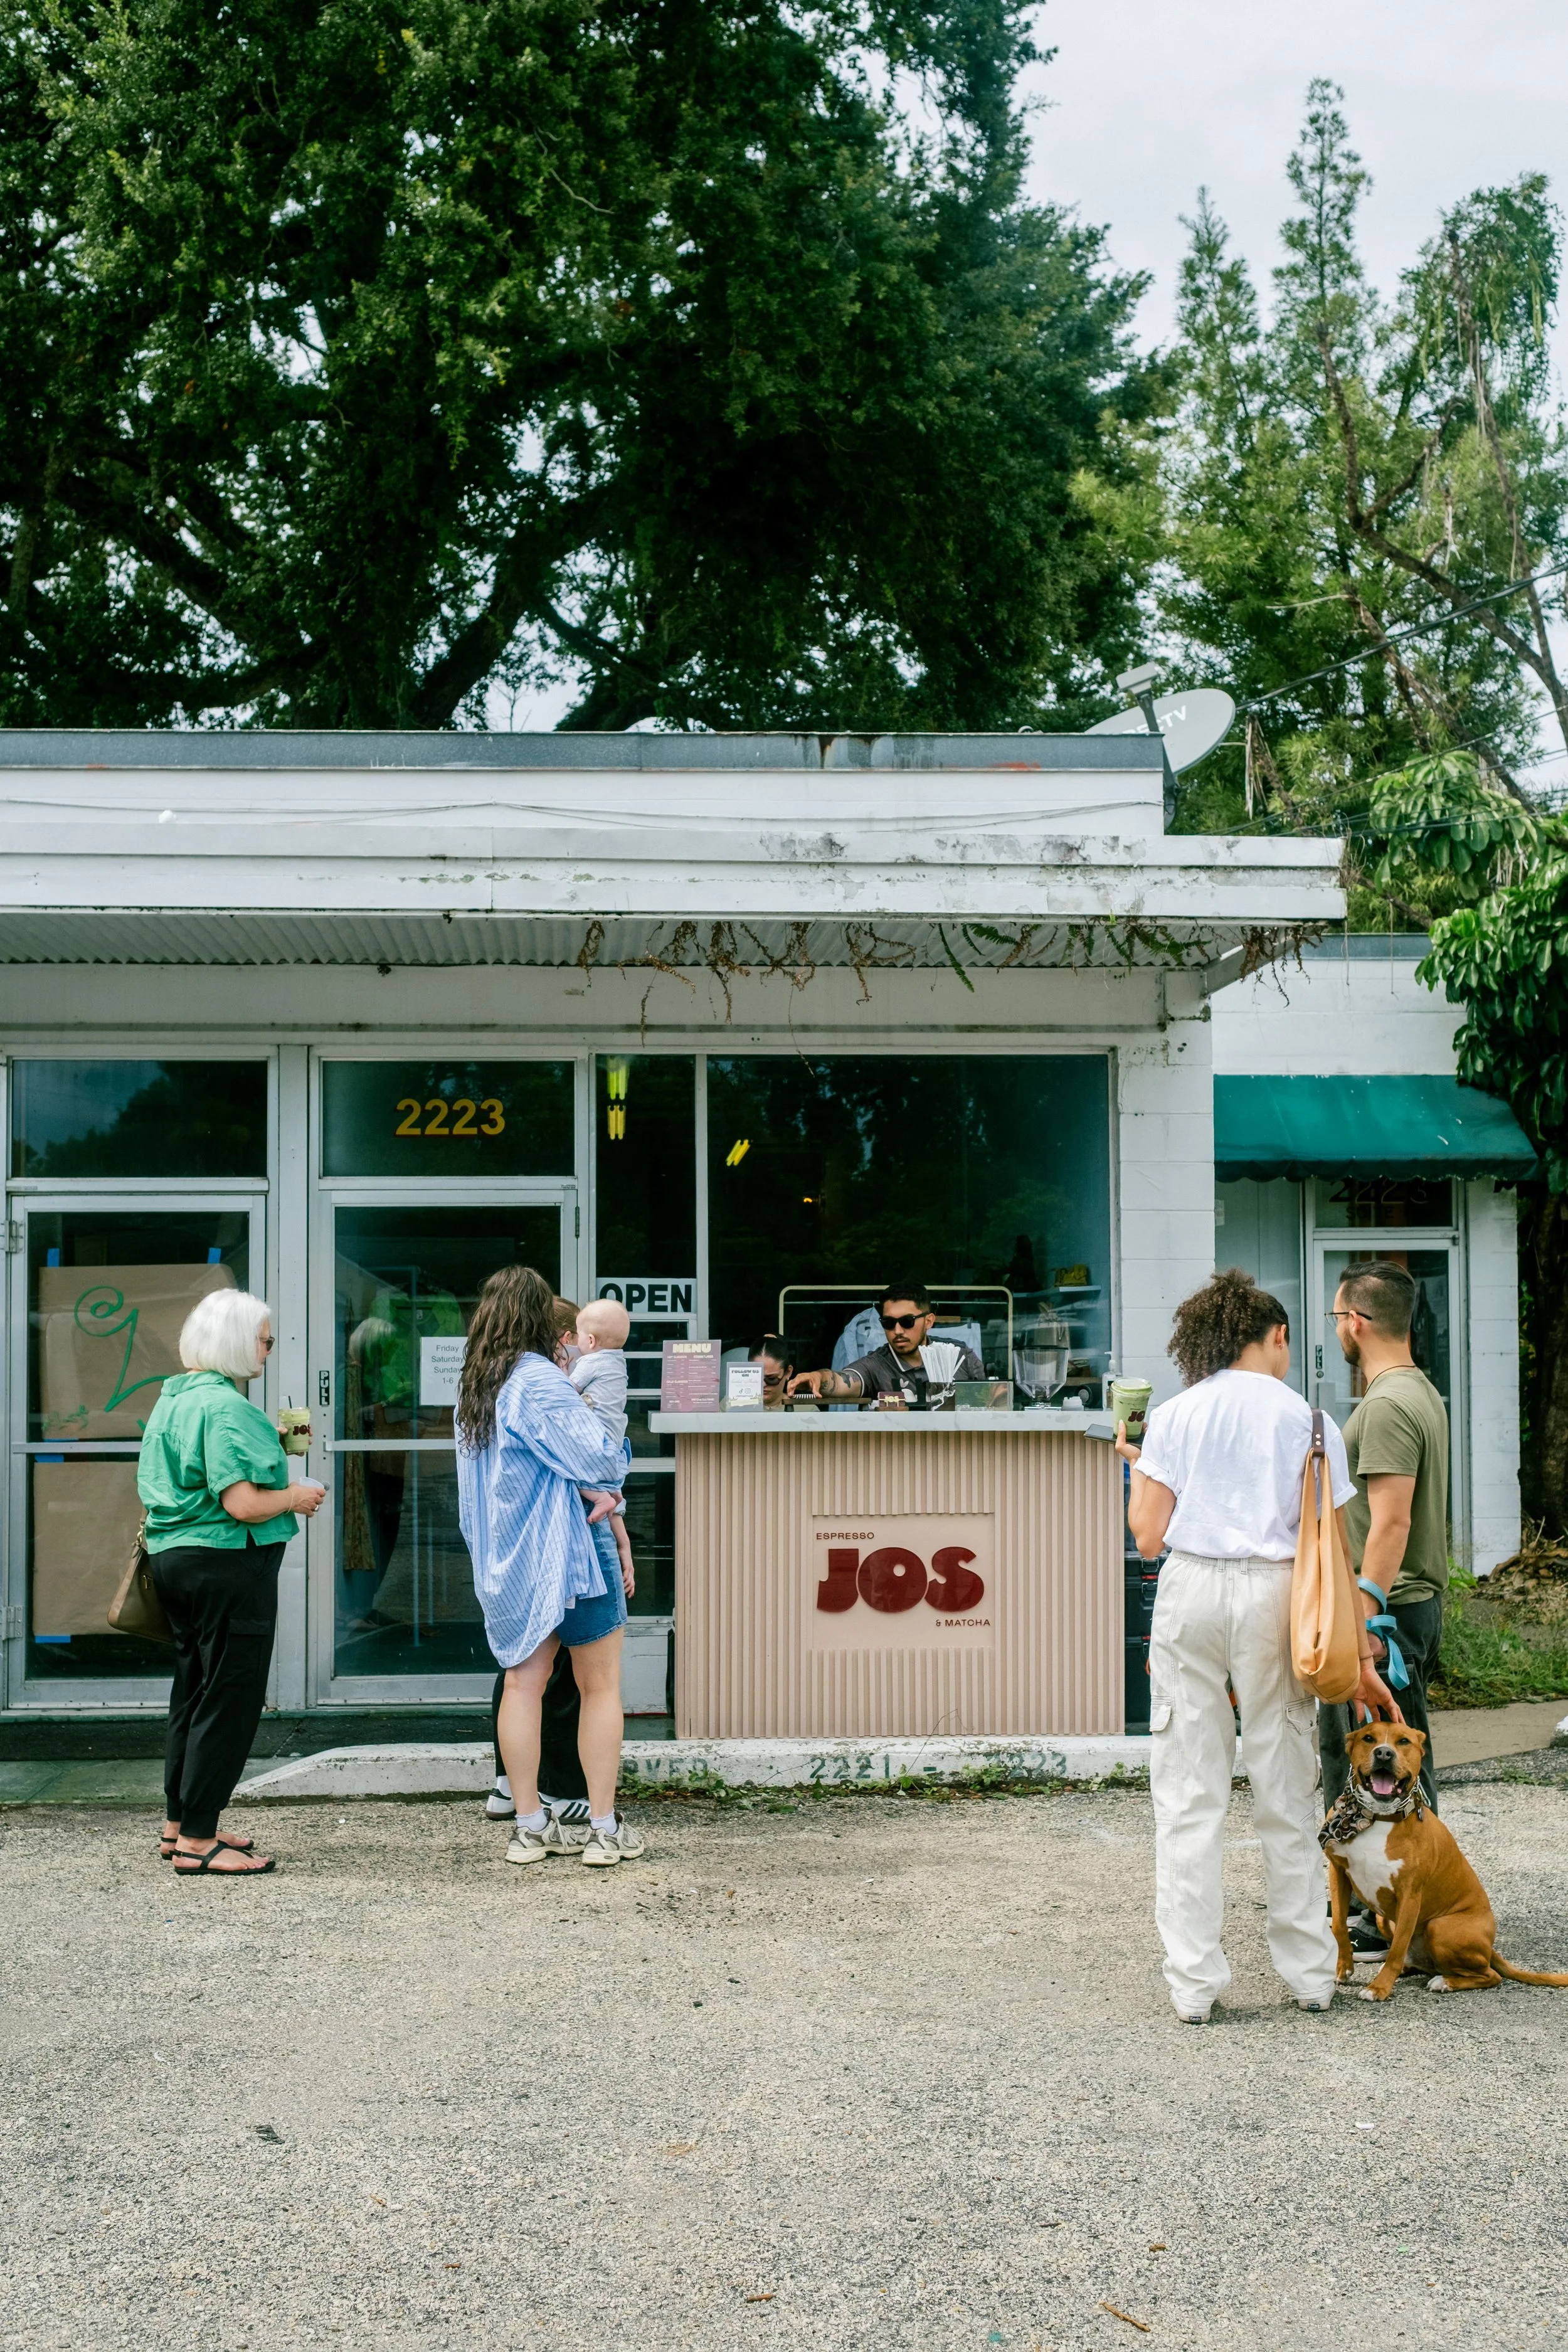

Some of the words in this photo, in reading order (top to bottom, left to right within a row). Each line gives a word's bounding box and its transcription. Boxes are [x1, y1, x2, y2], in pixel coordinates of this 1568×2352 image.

[394, 1098, 506, 1137] 2223
[599, 1283, 692, 1312] OPEN
[432, 1355, 464, 1364] Saturday
[436, 1345, 459, 1353] Friday
[672, 1343, 711, 1353] MENU
[434, 1367, 462, 1375] Sunday
[320, 1371, 329, 1405] PULL
[817, 1546, 985, 1613] JOS
[809, 1754, 890, 1779] 2221
